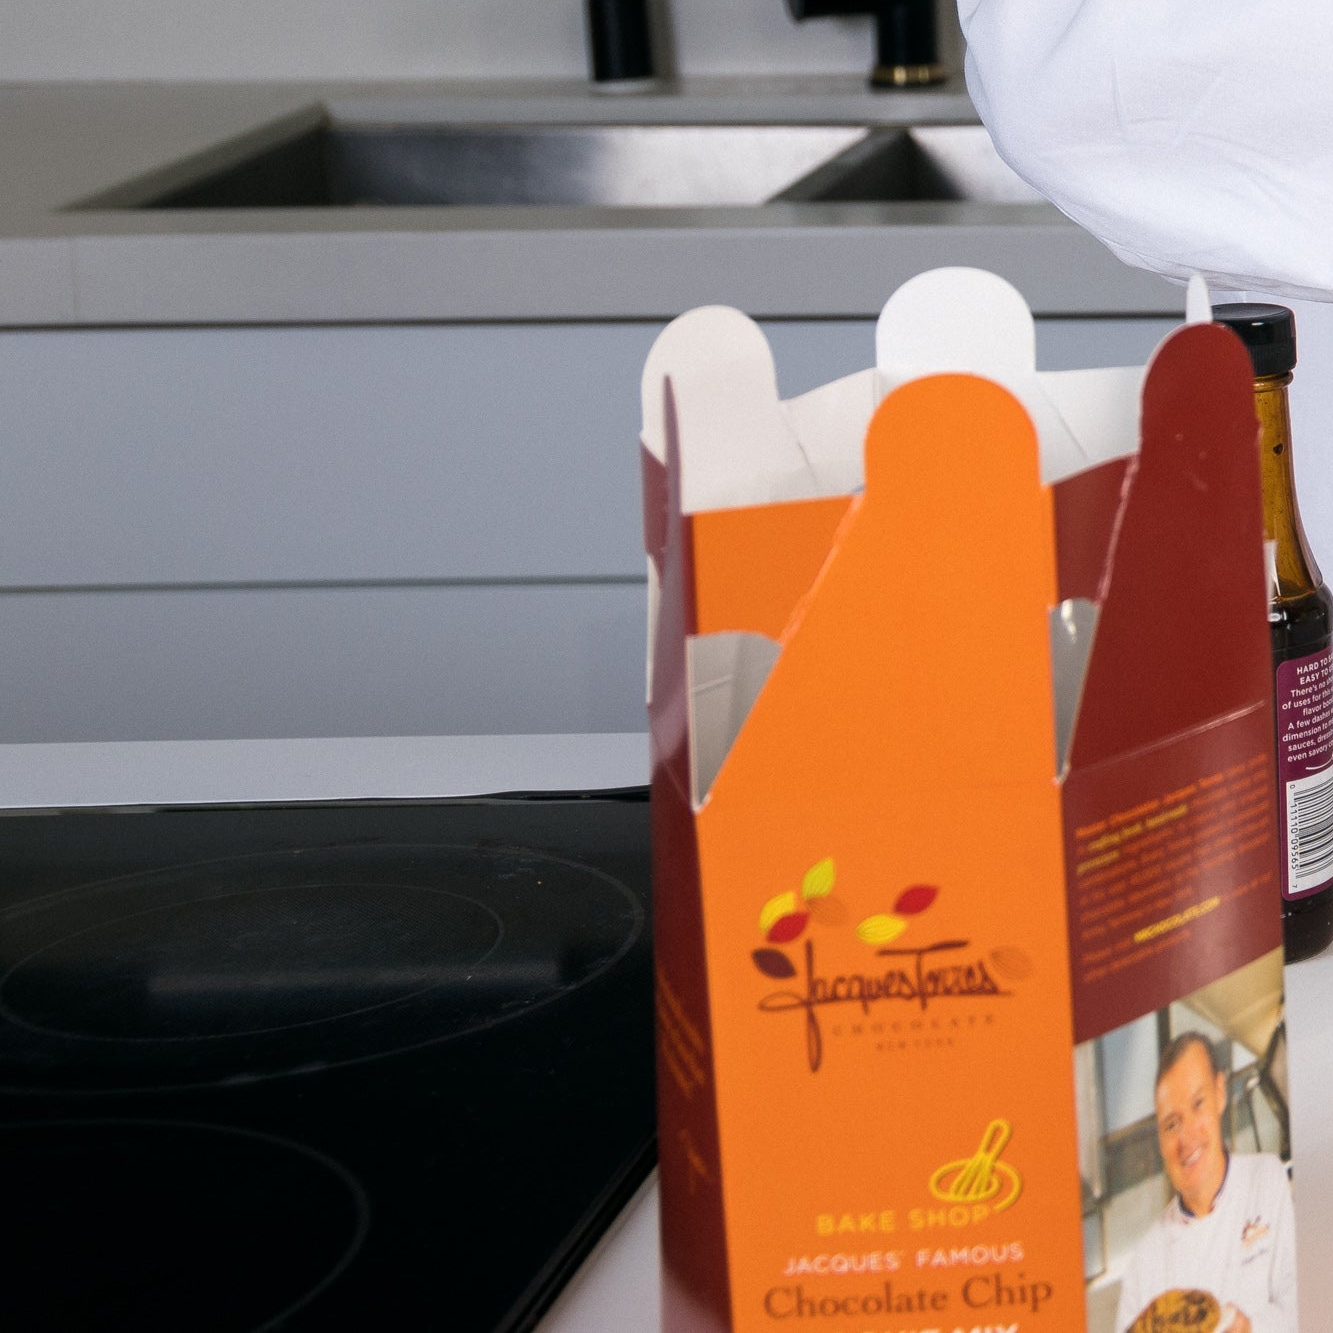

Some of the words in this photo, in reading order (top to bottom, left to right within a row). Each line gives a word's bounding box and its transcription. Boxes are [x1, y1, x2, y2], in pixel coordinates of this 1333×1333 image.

[1296, 662, 1319, 675] HARD
[1320, 657, 1328, 667] TO
[1300, 672, 1320, 685] EASY
[1321, 668, 1329, 677] TO
[1282, 701, 1291, 710] of
[1293, 698, 1311, 708] uses
[1312, 694, 1321, 703] for
[1322, 688, 1331, 698] this
[1290, 684, 1318, 698] There's
[1319, 681, 1326, 689] no
[1303, 704, 1322, 716] flavor
[1288, 722, 1295, 731] A
[1296, 719, 1311, 728] few
[1312, 710, 1330, 724] dashes
[1282, 725, 1322, 742] dimension
[1322, 722, 1328, 730] to
[1287, 752, 1307, 763] even
[1308, 744, 1328, 758] savory
[1288, 739, 1317, 752] sauces,
[816, 1210, 896, 1236] BAKE
[908, 1205, 991, 1230] SHOP
[915, 1241, 1025, 1268] FAMOUS
[763, 1280, 949, 1320] Chocolate
[961, 1270, 1054, 1313] Chip
